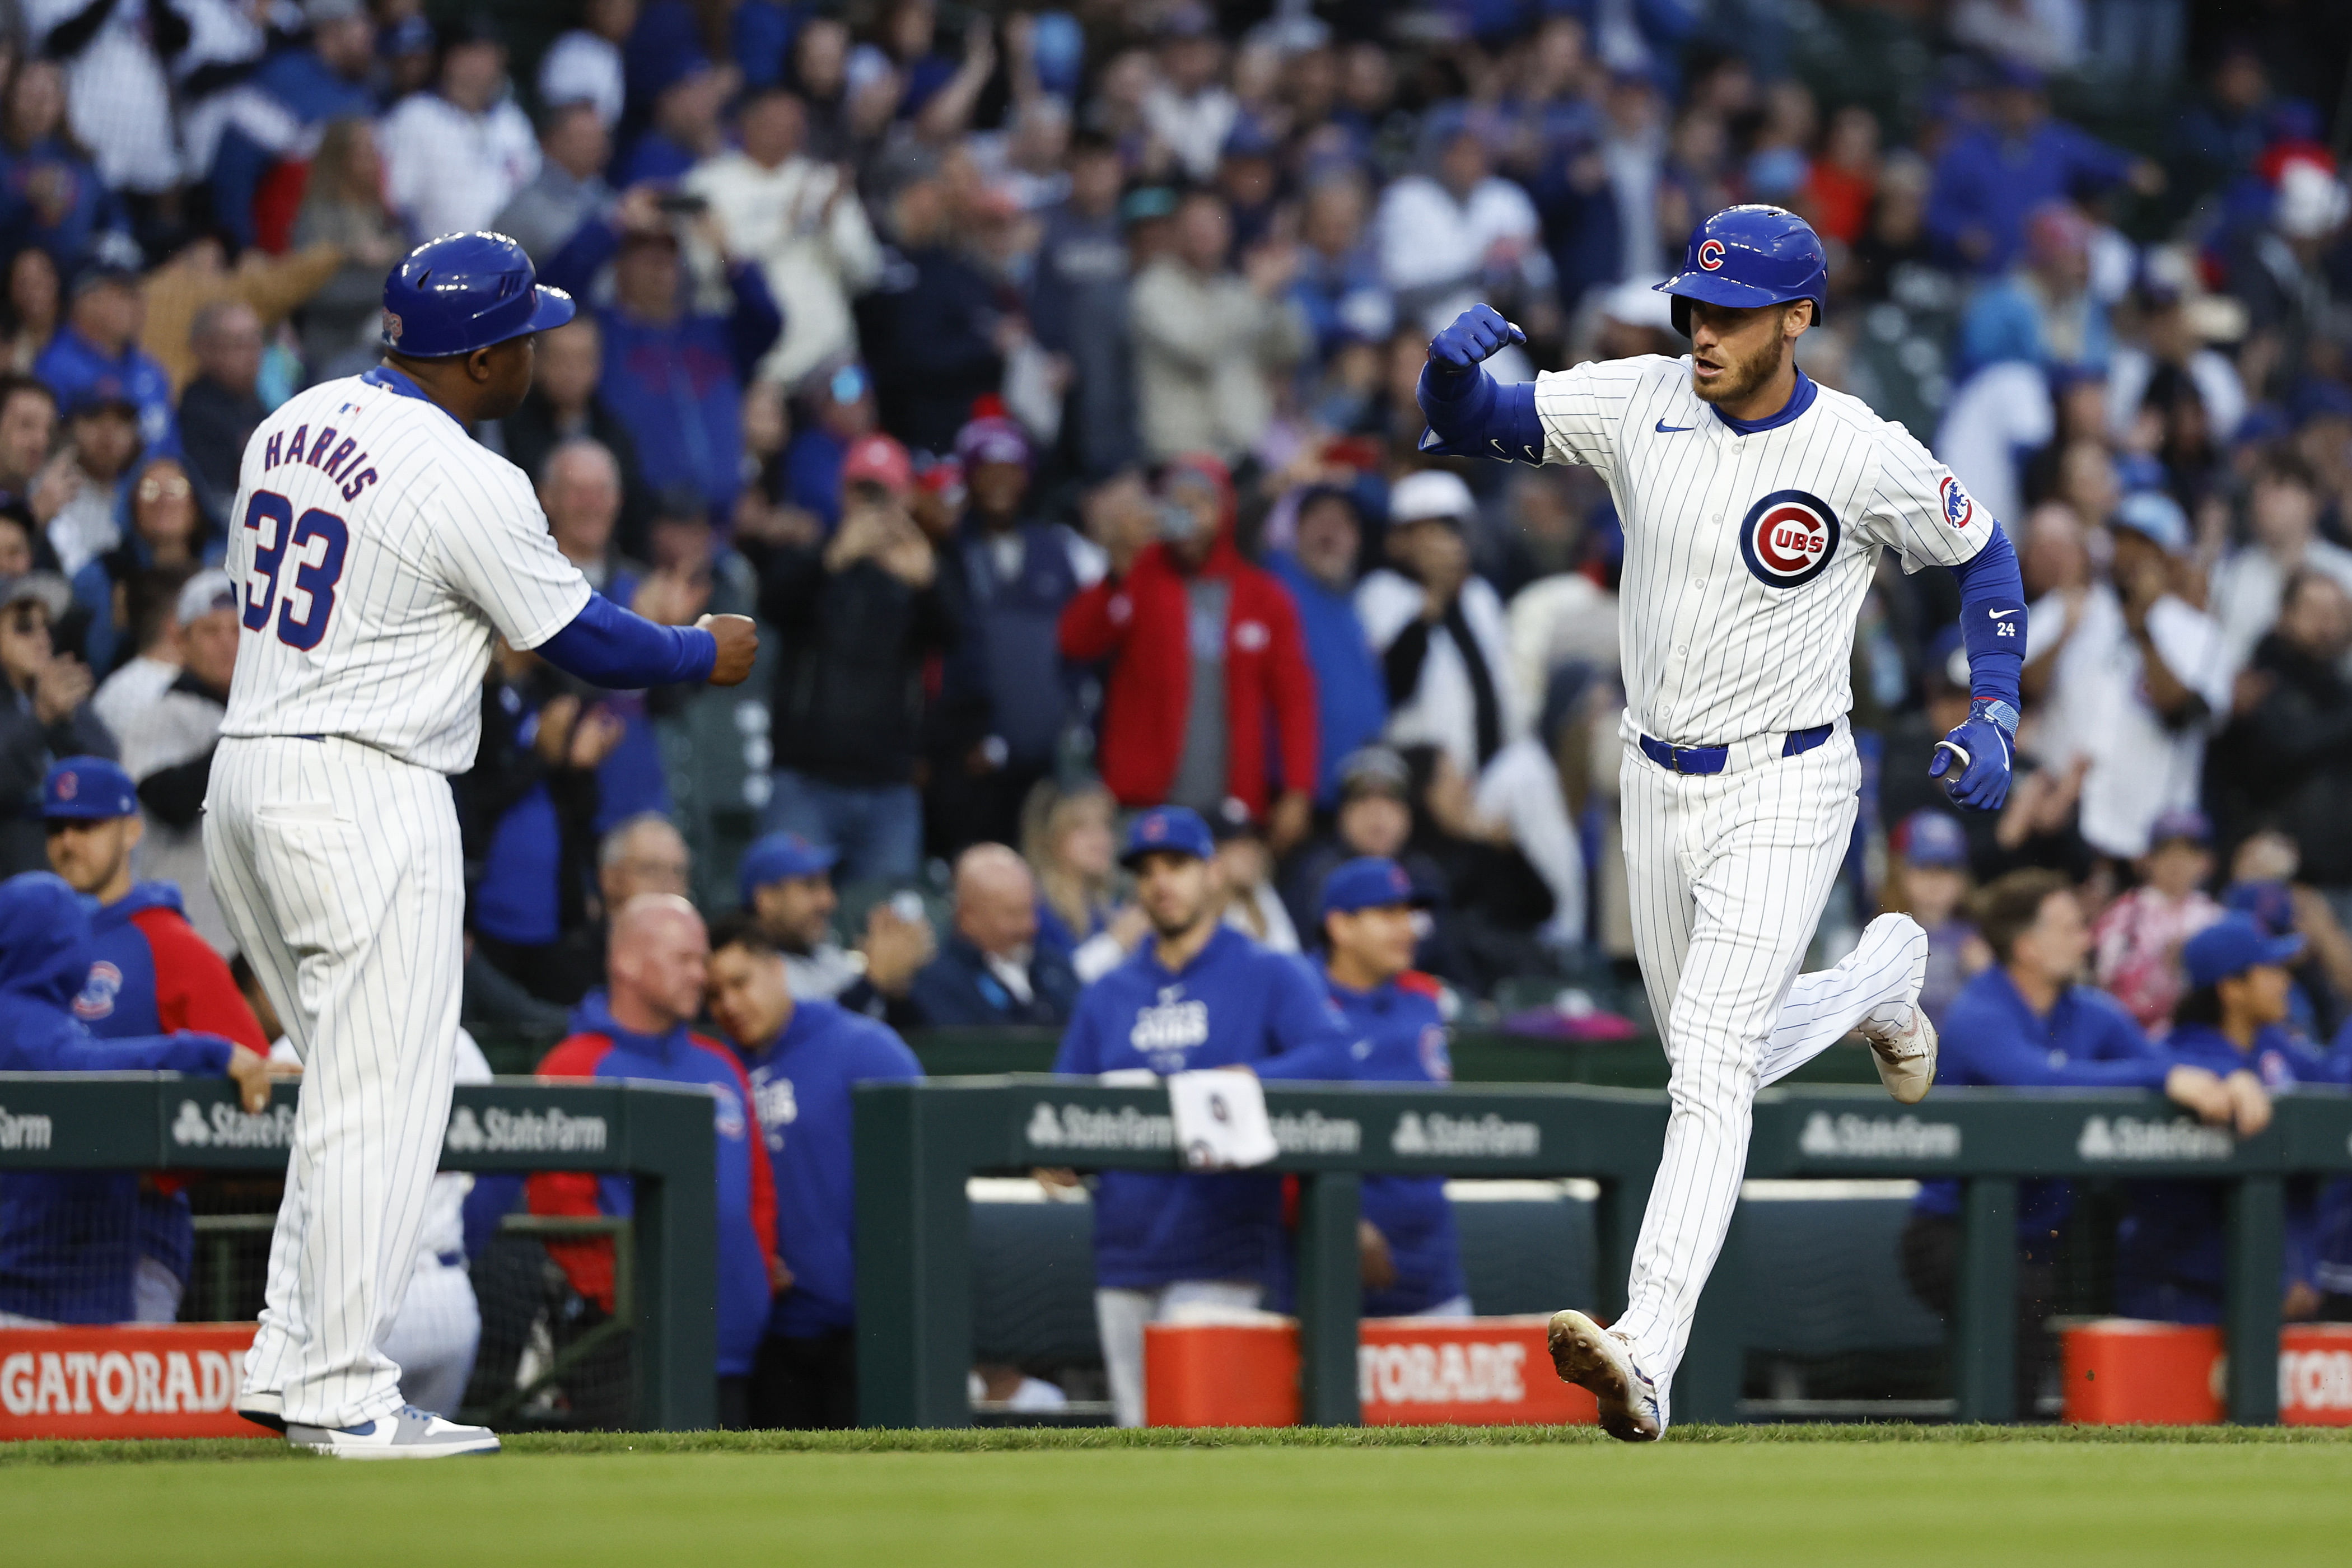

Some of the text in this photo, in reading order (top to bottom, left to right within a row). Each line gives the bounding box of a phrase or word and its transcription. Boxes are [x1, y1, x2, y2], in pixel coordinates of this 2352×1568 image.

[1698, 239, 1725, 271] C
[265, 424, 379, 502] HARRIS
[1758, 507, 1824, 571] CUBS
[243, 489, 349, 652] 33
[1997, 622, 2015, 637] 24
[1358, 1342, 1527, 1403] TORADE
